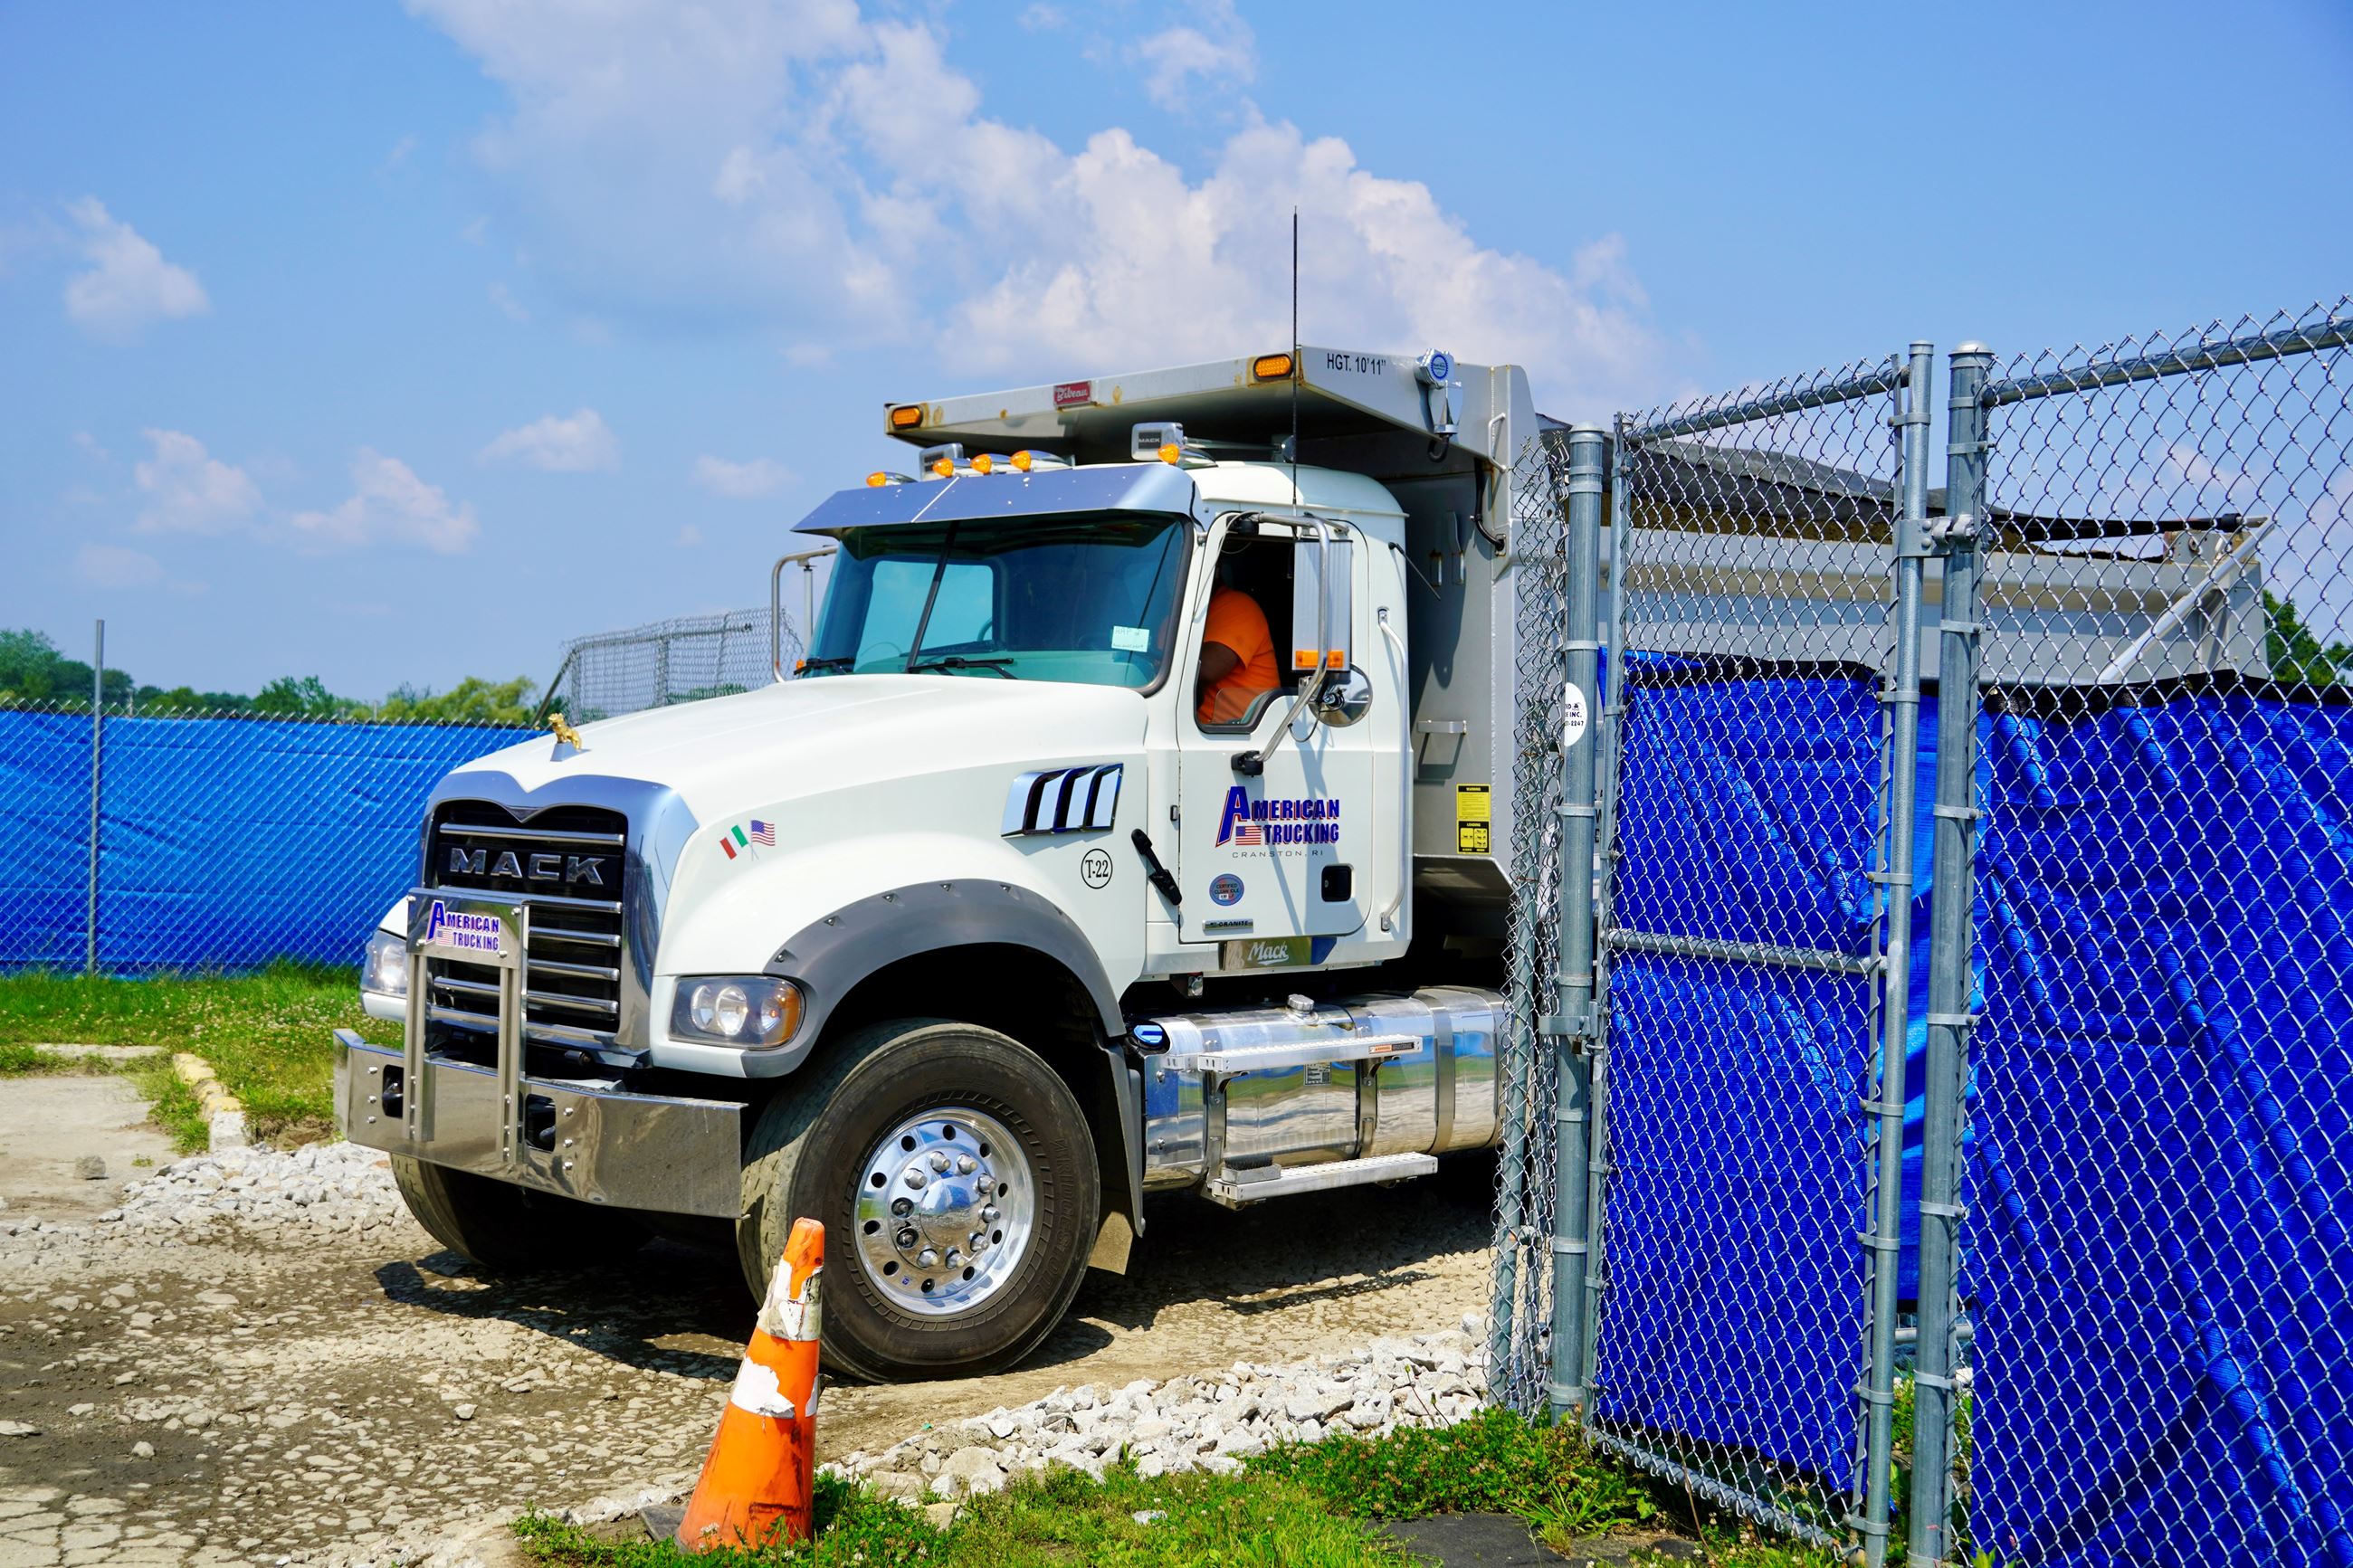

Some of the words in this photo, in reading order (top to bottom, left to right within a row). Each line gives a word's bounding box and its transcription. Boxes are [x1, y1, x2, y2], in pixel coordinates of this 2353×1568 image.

[1327, 352, 1352, 372] HGT.
[1262, 823, 1340, 845] TRUCKING
[450, 847, 605, 886] MACK
[1085, 859, 1110, 879] T-22
[452, 931, 500, 952] TRUCKING
[1247, 941, 1290, 965] Mack
